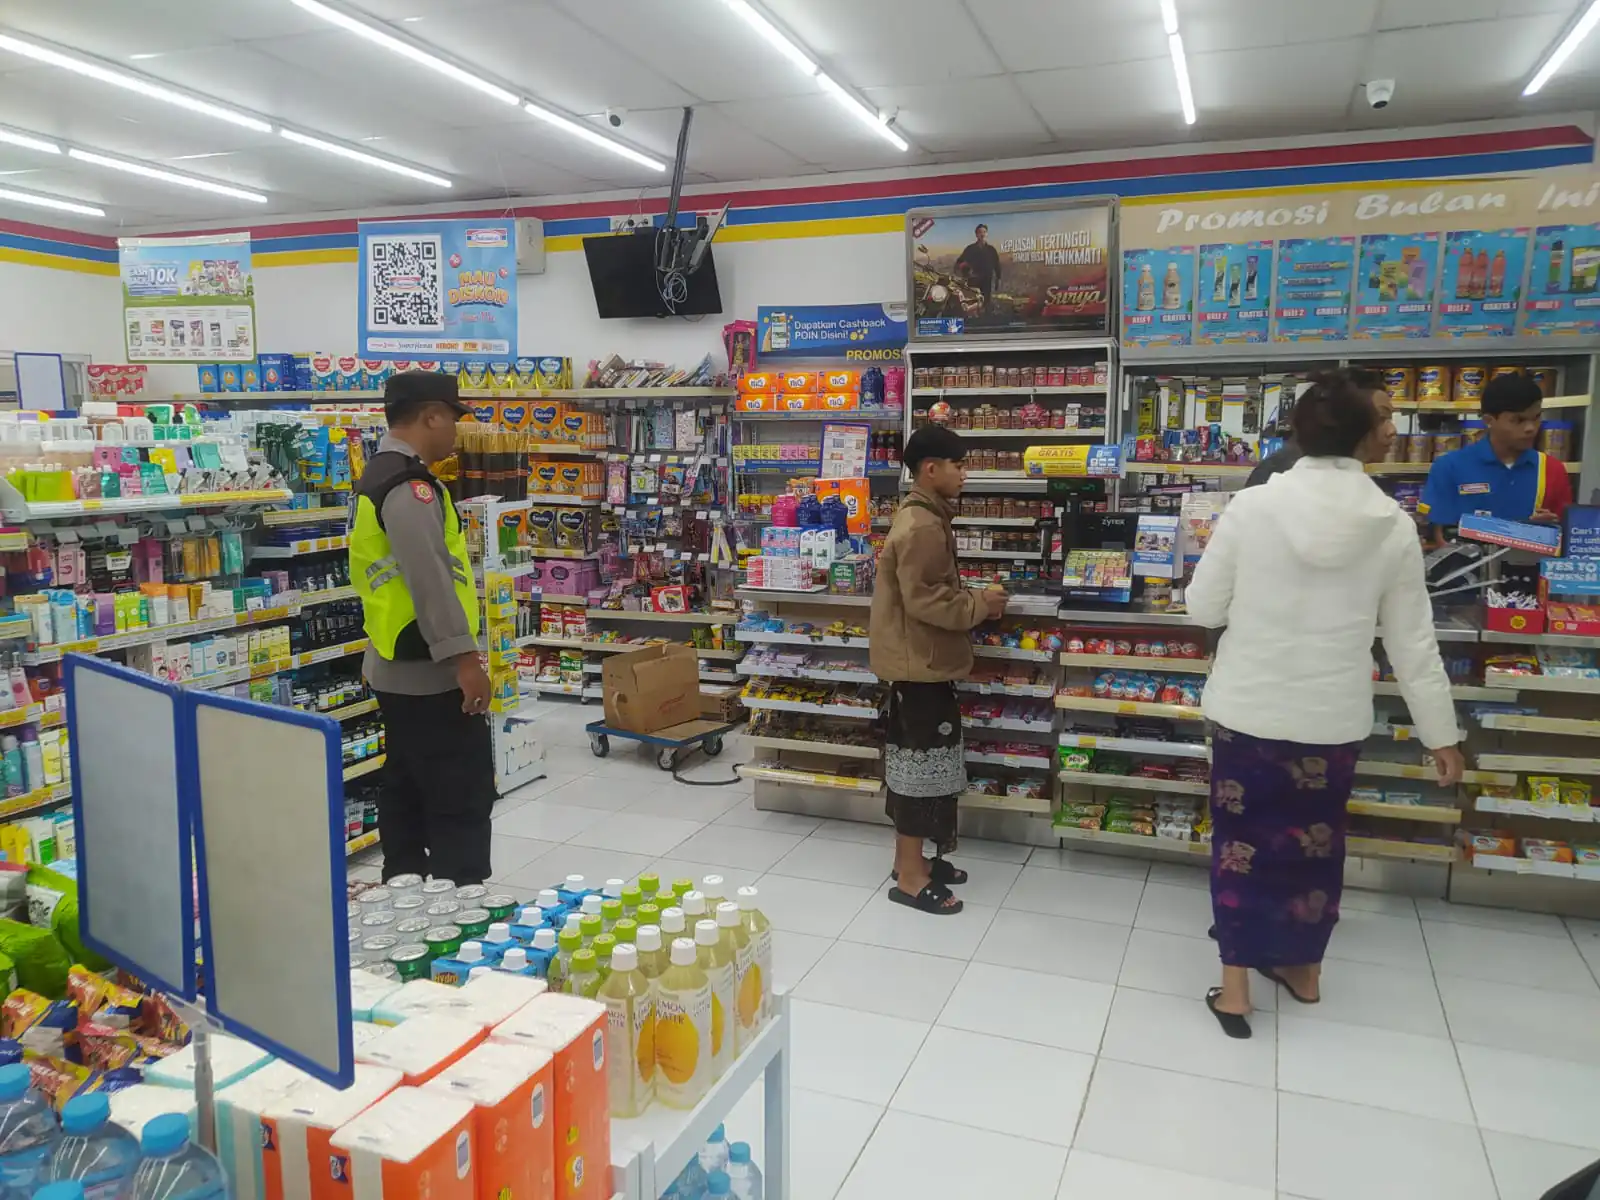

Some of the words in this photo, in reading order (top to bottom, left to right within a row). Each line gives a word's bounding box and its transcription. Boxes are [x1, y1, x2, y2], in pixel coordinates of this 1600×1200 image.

[1157, 200, 1328, 234] Promosi
[1355, 189, 1507, 220] Bulan
[1537, 180, 1600, 211] Ini
[458, 270, 496, 287] MAU
[448, 286, 509, 305] DISKON
[794, 320, 837, 330] Dapatkan
[838, 318, 886, 329] Cashback
[794, 330, 818, 340] POIN
[1545, 561, 1574, 571] YES
[1578, 561, 1597, 572] TO
